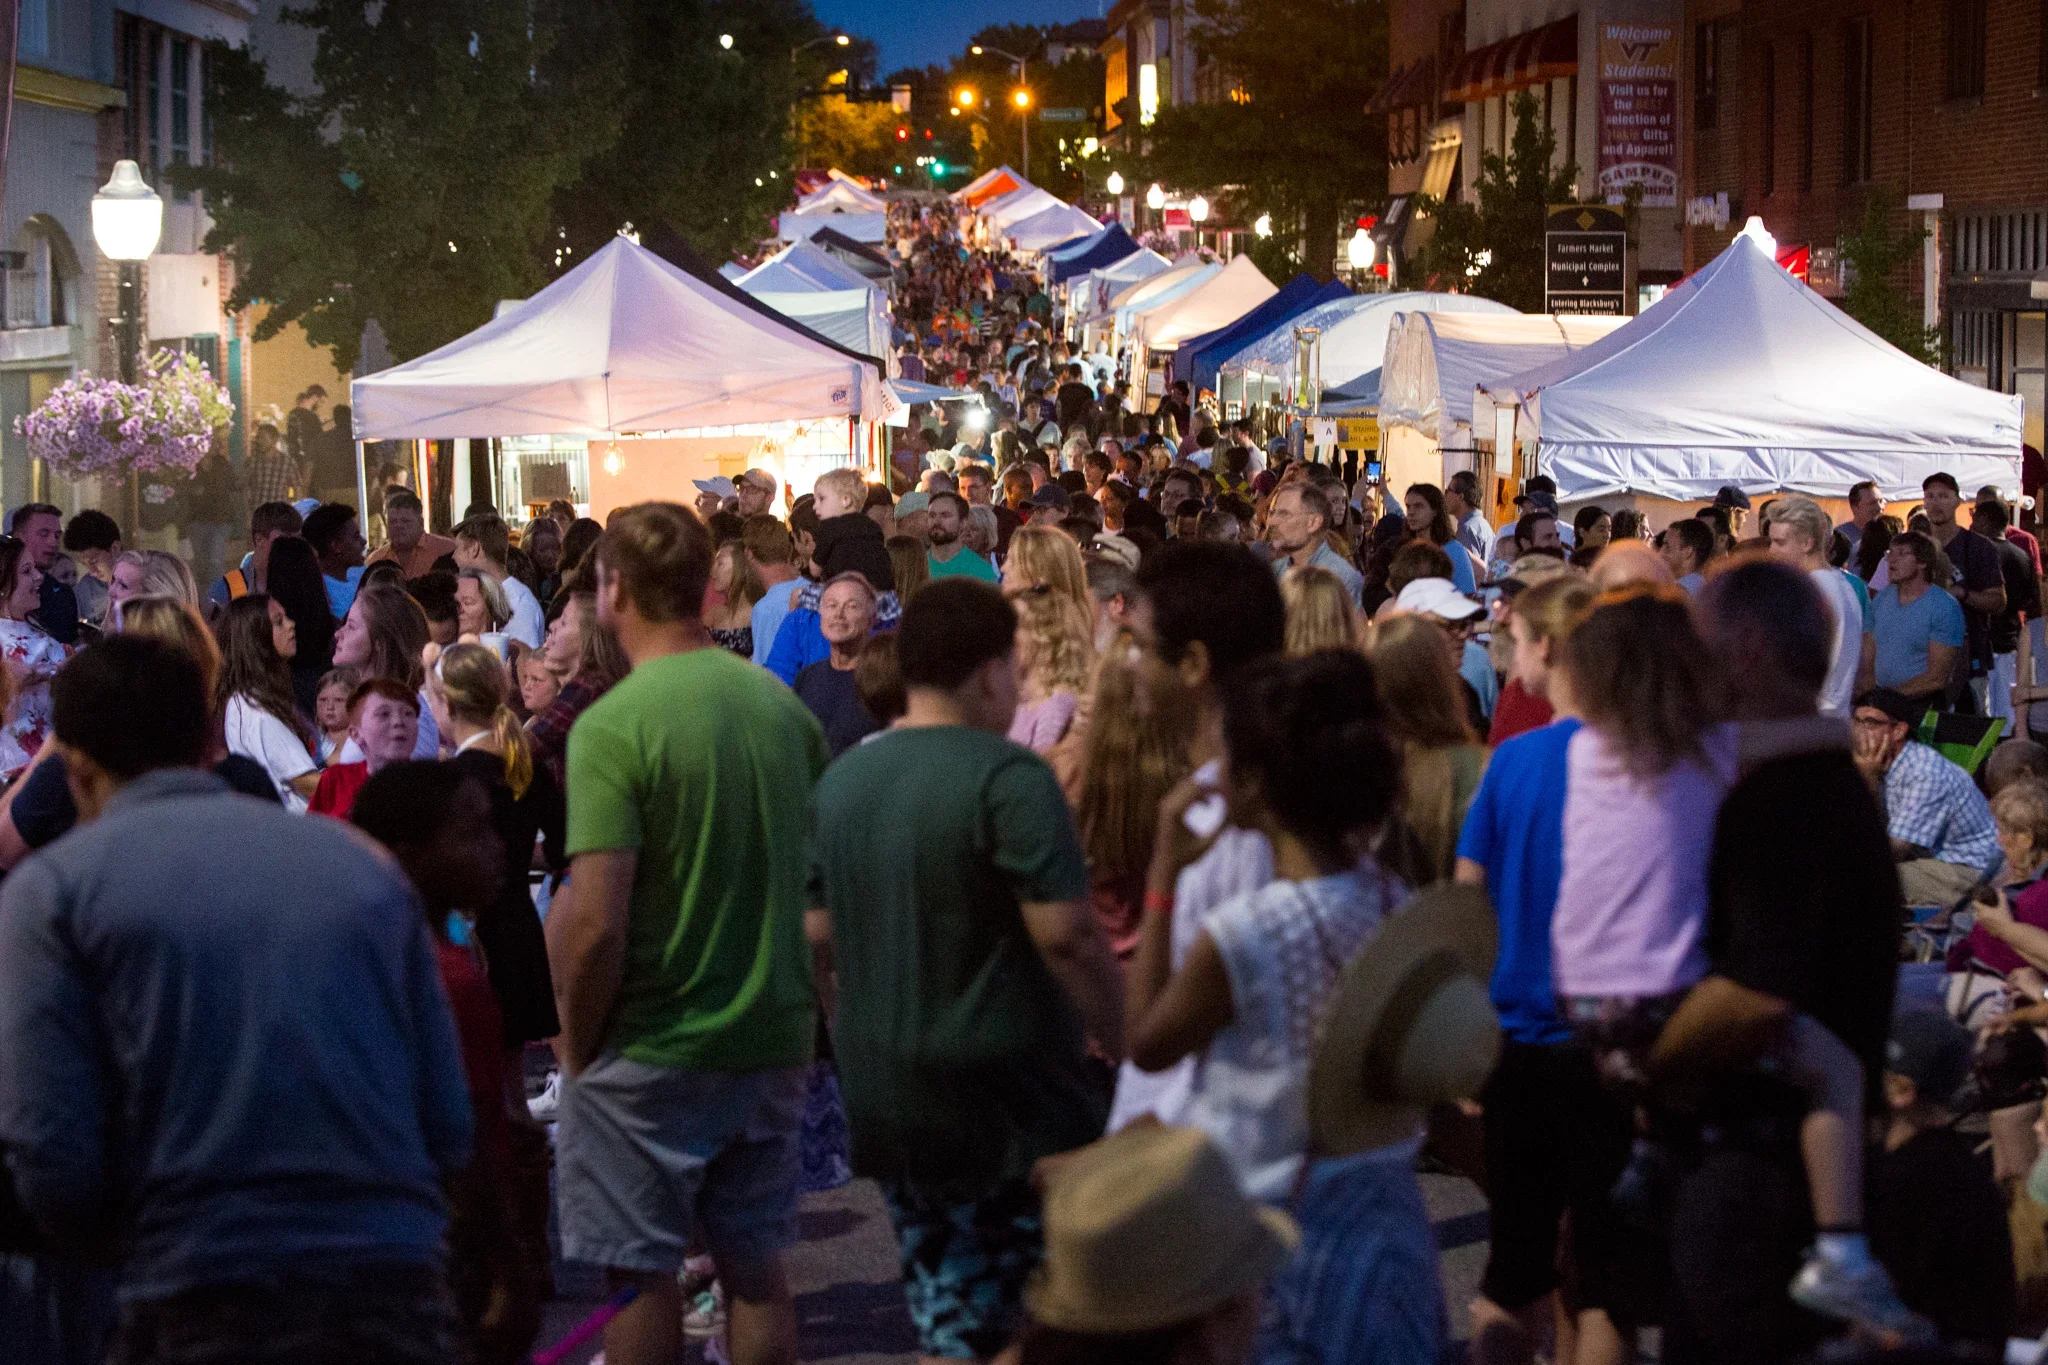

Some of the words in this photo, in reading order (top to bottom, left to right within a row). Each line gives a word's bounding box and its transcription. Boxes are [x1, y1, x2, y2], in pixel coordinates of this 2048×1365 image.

[1606, 25, 1672, 40] Welcome
[1619, 41, 1661, 62] VT
[1604, 63, 1673, 79] Students!
[1608, 84, 1633, 96] Visit
[1636, 86, 1650, 96] us
[1653, 84, 1668, 97] for
[1613, 99, 1632, 110] the
[1606, 112, 1656, 126] selection
[1659, 112, 1671, 126] of
[1642, 128, 1669, 141] Gifts
[1602, 143, 1623, 156] and
[1601, 165, 1674, 185] CAMPUS
[1557, 243, 1587, 253] Farmers
[1589, 243, 1614, 253] Market
[1551, 261, 1587, 273] Municipal
[1588, 261, 1620, 273] Complex
[1551, 299, 1578, 309] Entering
[1579, 299, 1620, 310] Blacksburg's
